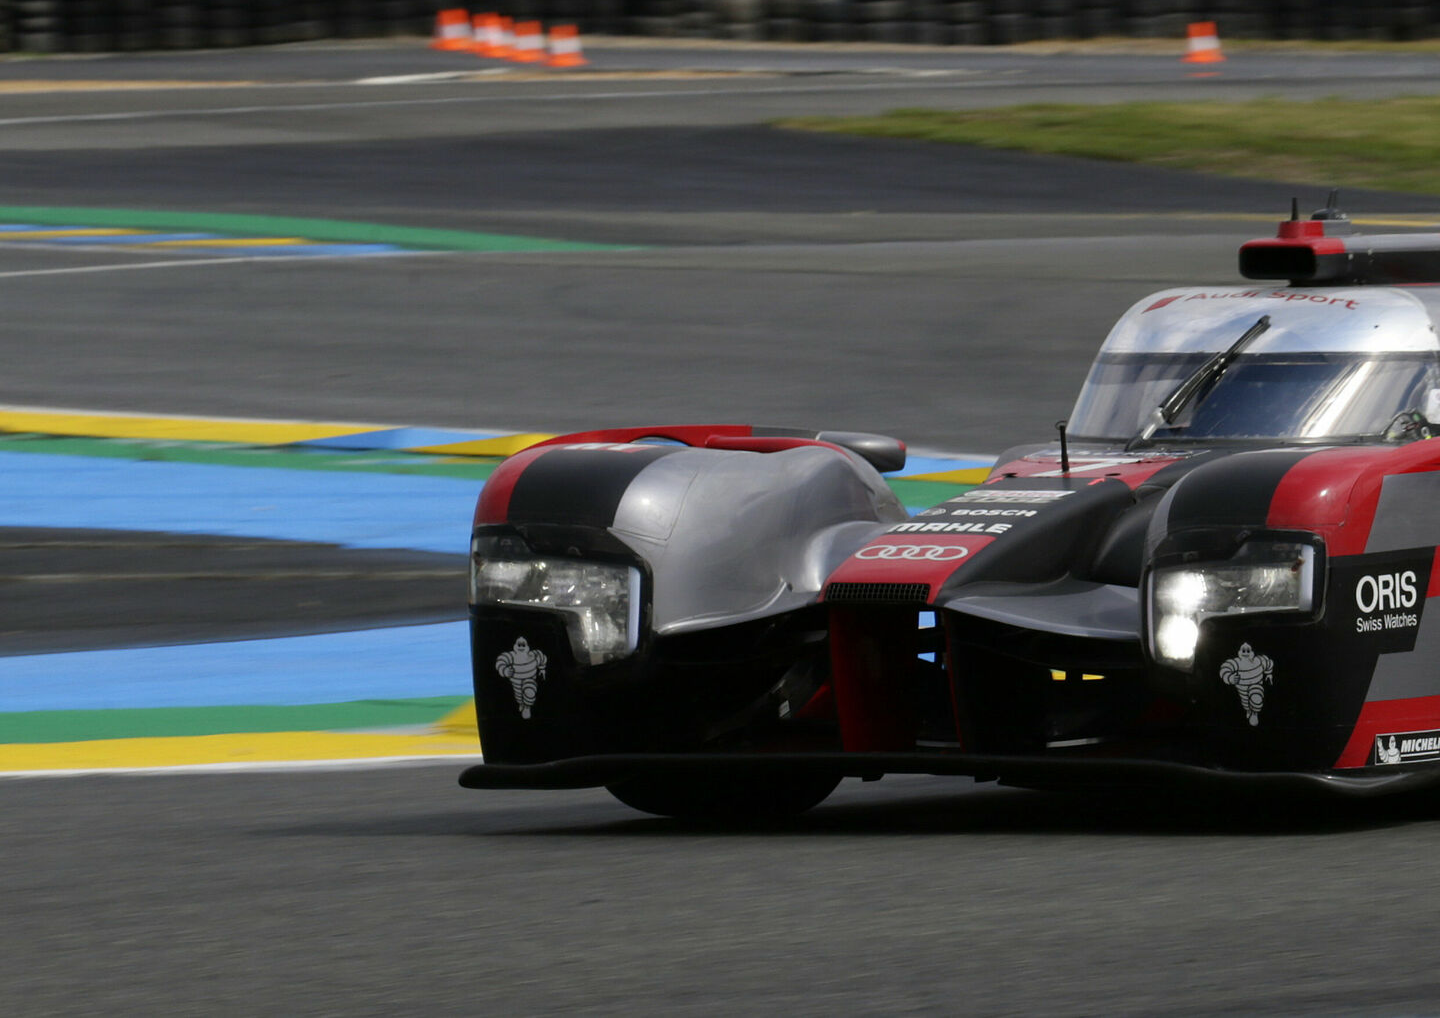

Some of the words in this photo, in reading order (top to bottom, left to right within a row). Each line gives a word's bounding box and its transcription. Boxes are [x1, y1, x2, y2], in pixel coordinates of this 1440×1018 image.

[1185, 290, 1259, 302] Audi
[1271, 291, 1360, 310] Sport
[950, 509, 1038, 518] BOSCH
[887, 522, 1013, 534] MAHLE
[1355, 570, 1417, 613] ORIS
[1356, 617, 1383, 632] Swiss
[1383, 612, 1418, 630] Watches
